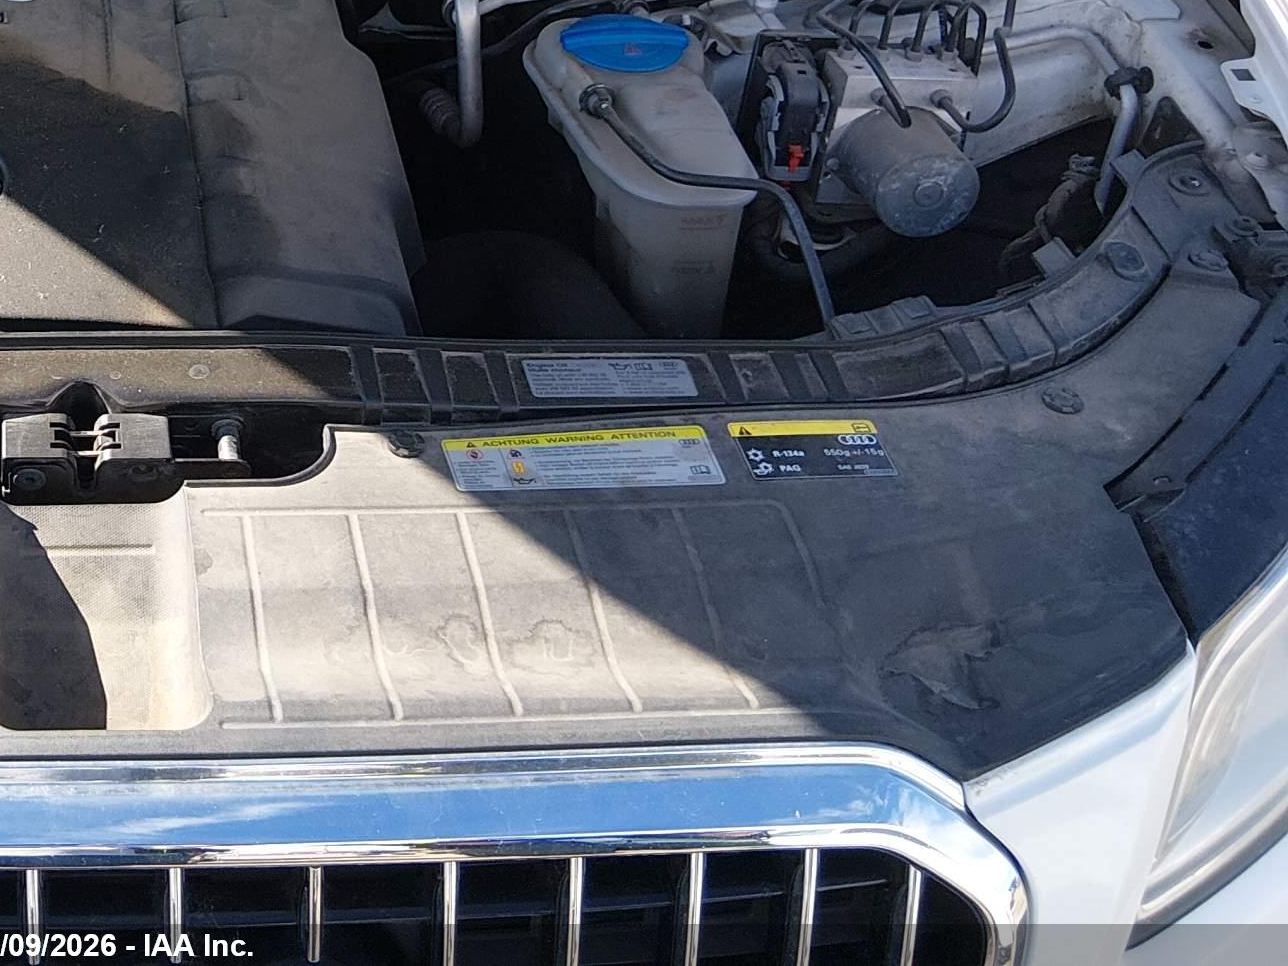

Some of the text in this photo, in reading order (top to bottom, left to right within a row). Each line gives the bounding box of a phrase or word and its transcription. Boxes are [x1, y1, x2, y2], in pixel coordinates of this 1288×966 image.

[482, 430, 677, 448] ACHTUNG WARNING ATTENTION
[771, 450, 805, 458] R-134a
[823, 448, 851, 458] 550g
[779, 464, 802, 472] PAG
